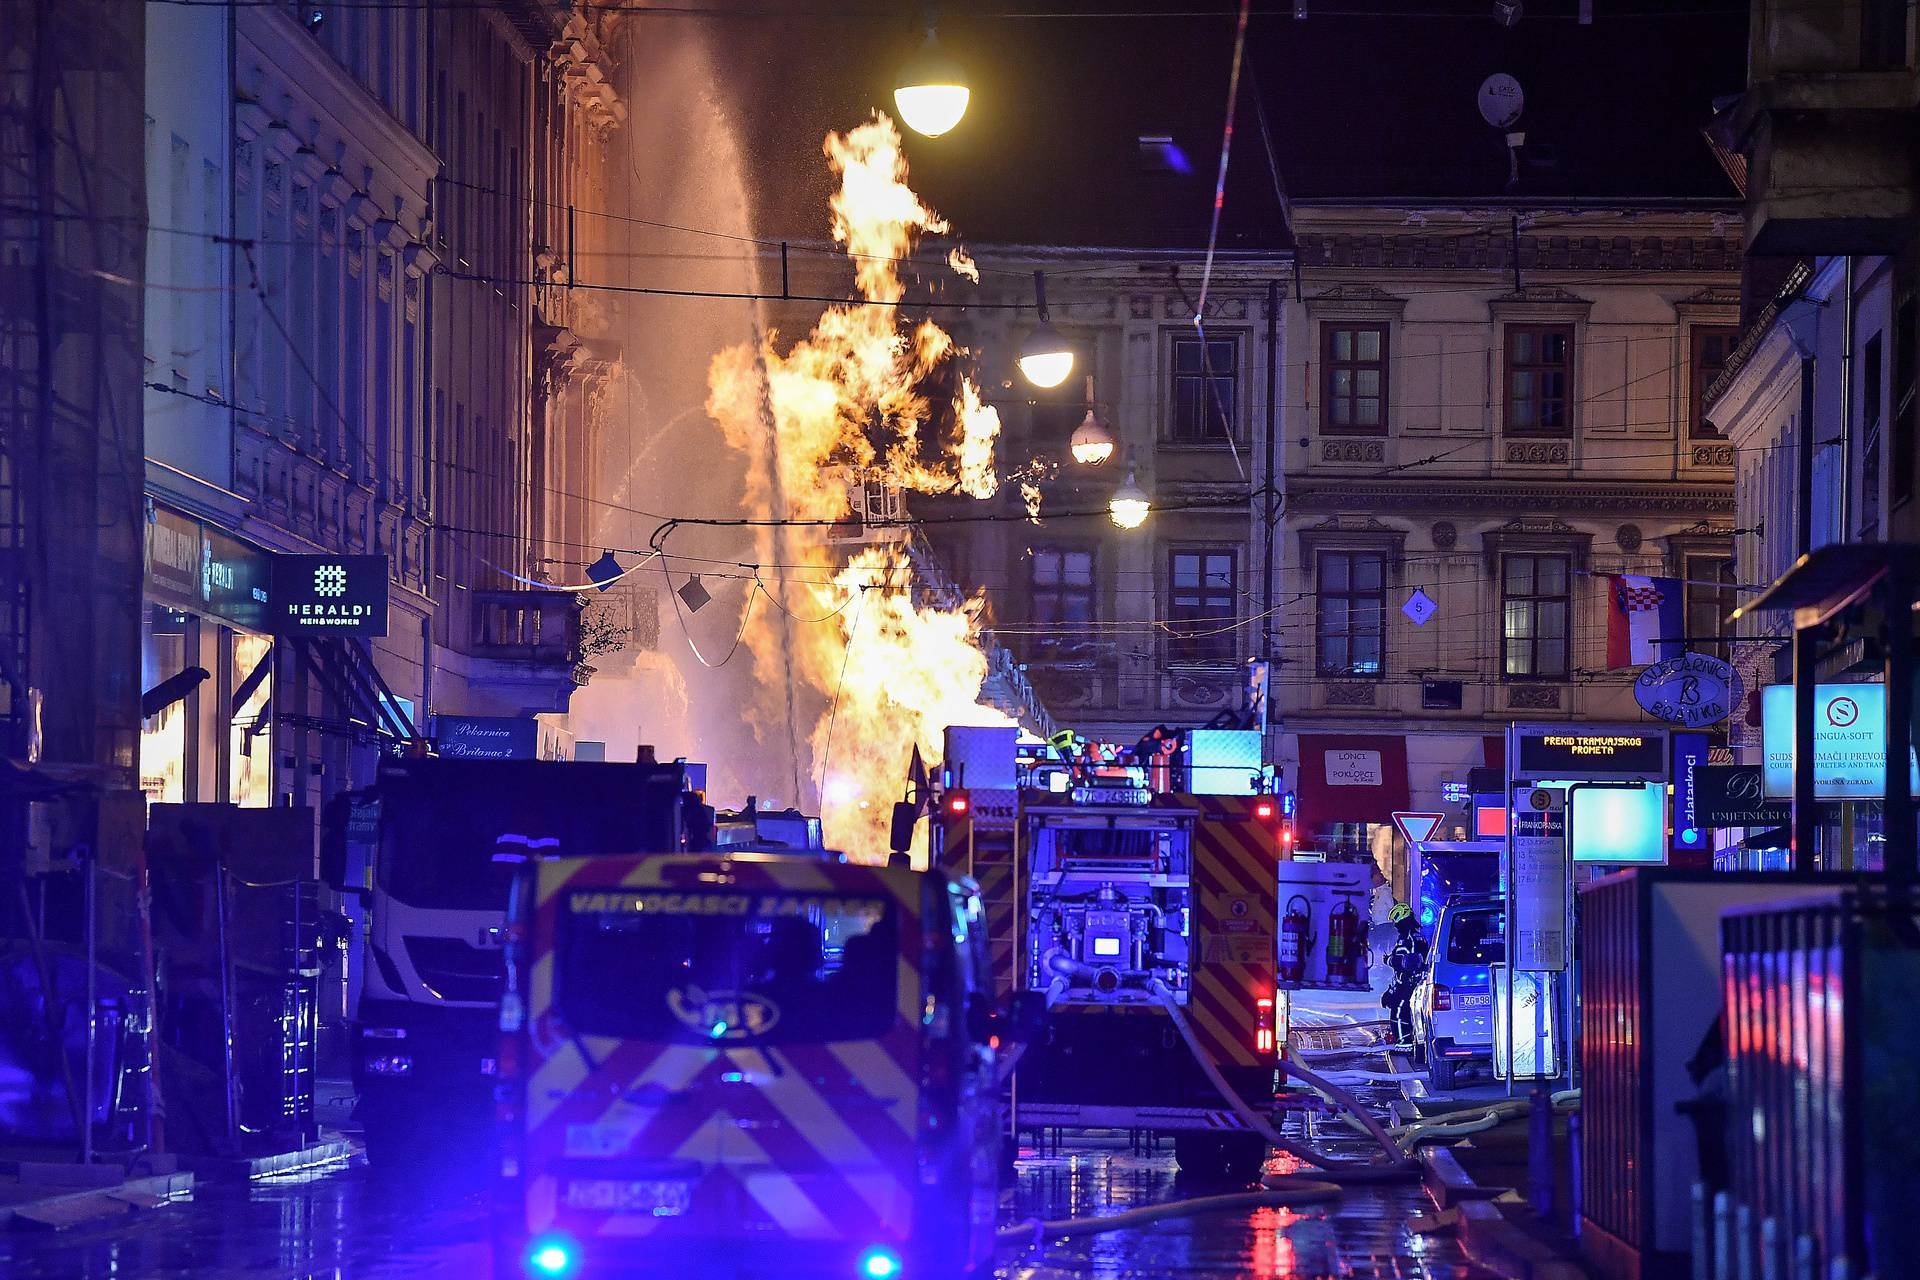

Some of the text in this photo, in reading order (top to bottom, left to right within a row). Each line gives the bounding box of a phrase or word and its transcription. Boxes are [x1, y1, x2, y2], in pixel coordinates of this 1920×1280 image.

[288, 604, 372, 616] HERALDI
[299, 618, 361, 626] MEN&WOMEN
[455, 722, 511, 738] Pekarnica
[1543, 736, 1642, 747] PREKID TRAMVAJSKOG
[451, 743, 513, 758] Britanac 2
[1571, 745, 1614, 755] PROMETA
[1521, 820, 1562, 830] FRANKOPANSKA
[1464, 996, 1475, 1005] ZG
